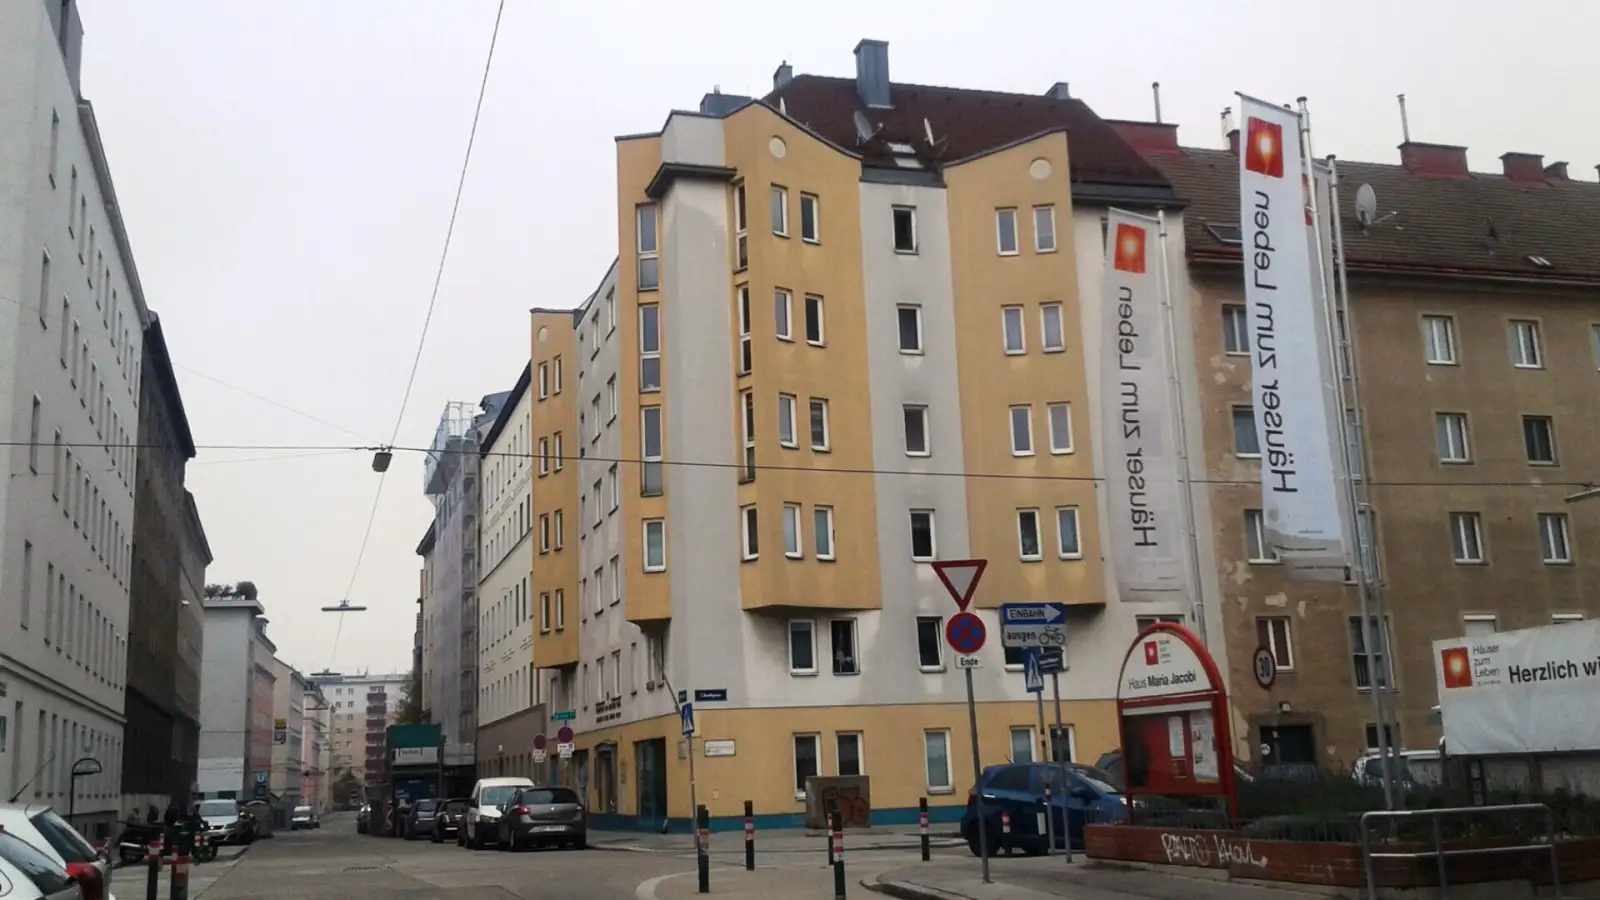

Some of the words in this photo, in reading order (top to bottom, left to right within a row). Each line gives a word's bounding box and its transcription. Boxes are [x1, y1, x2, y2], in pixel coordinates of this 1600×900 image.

[1009, 608, 1045, 619] EINBAHN
[1473, 644, 1500, 655] Häuser
[960, 656, 979, 667] Ende
[1258, 656, 1271, 678] 30
[1474, 656, 1491, 667] zum
[1475, 666, 1500, 678] Leben
[1508, 659, 1579, 684] Herzlich
[1128, 677, 1147, 690] Haus
[1147, 673, 1169, 688] Maria
[1170, 669, 1197, 685] Jacobi
